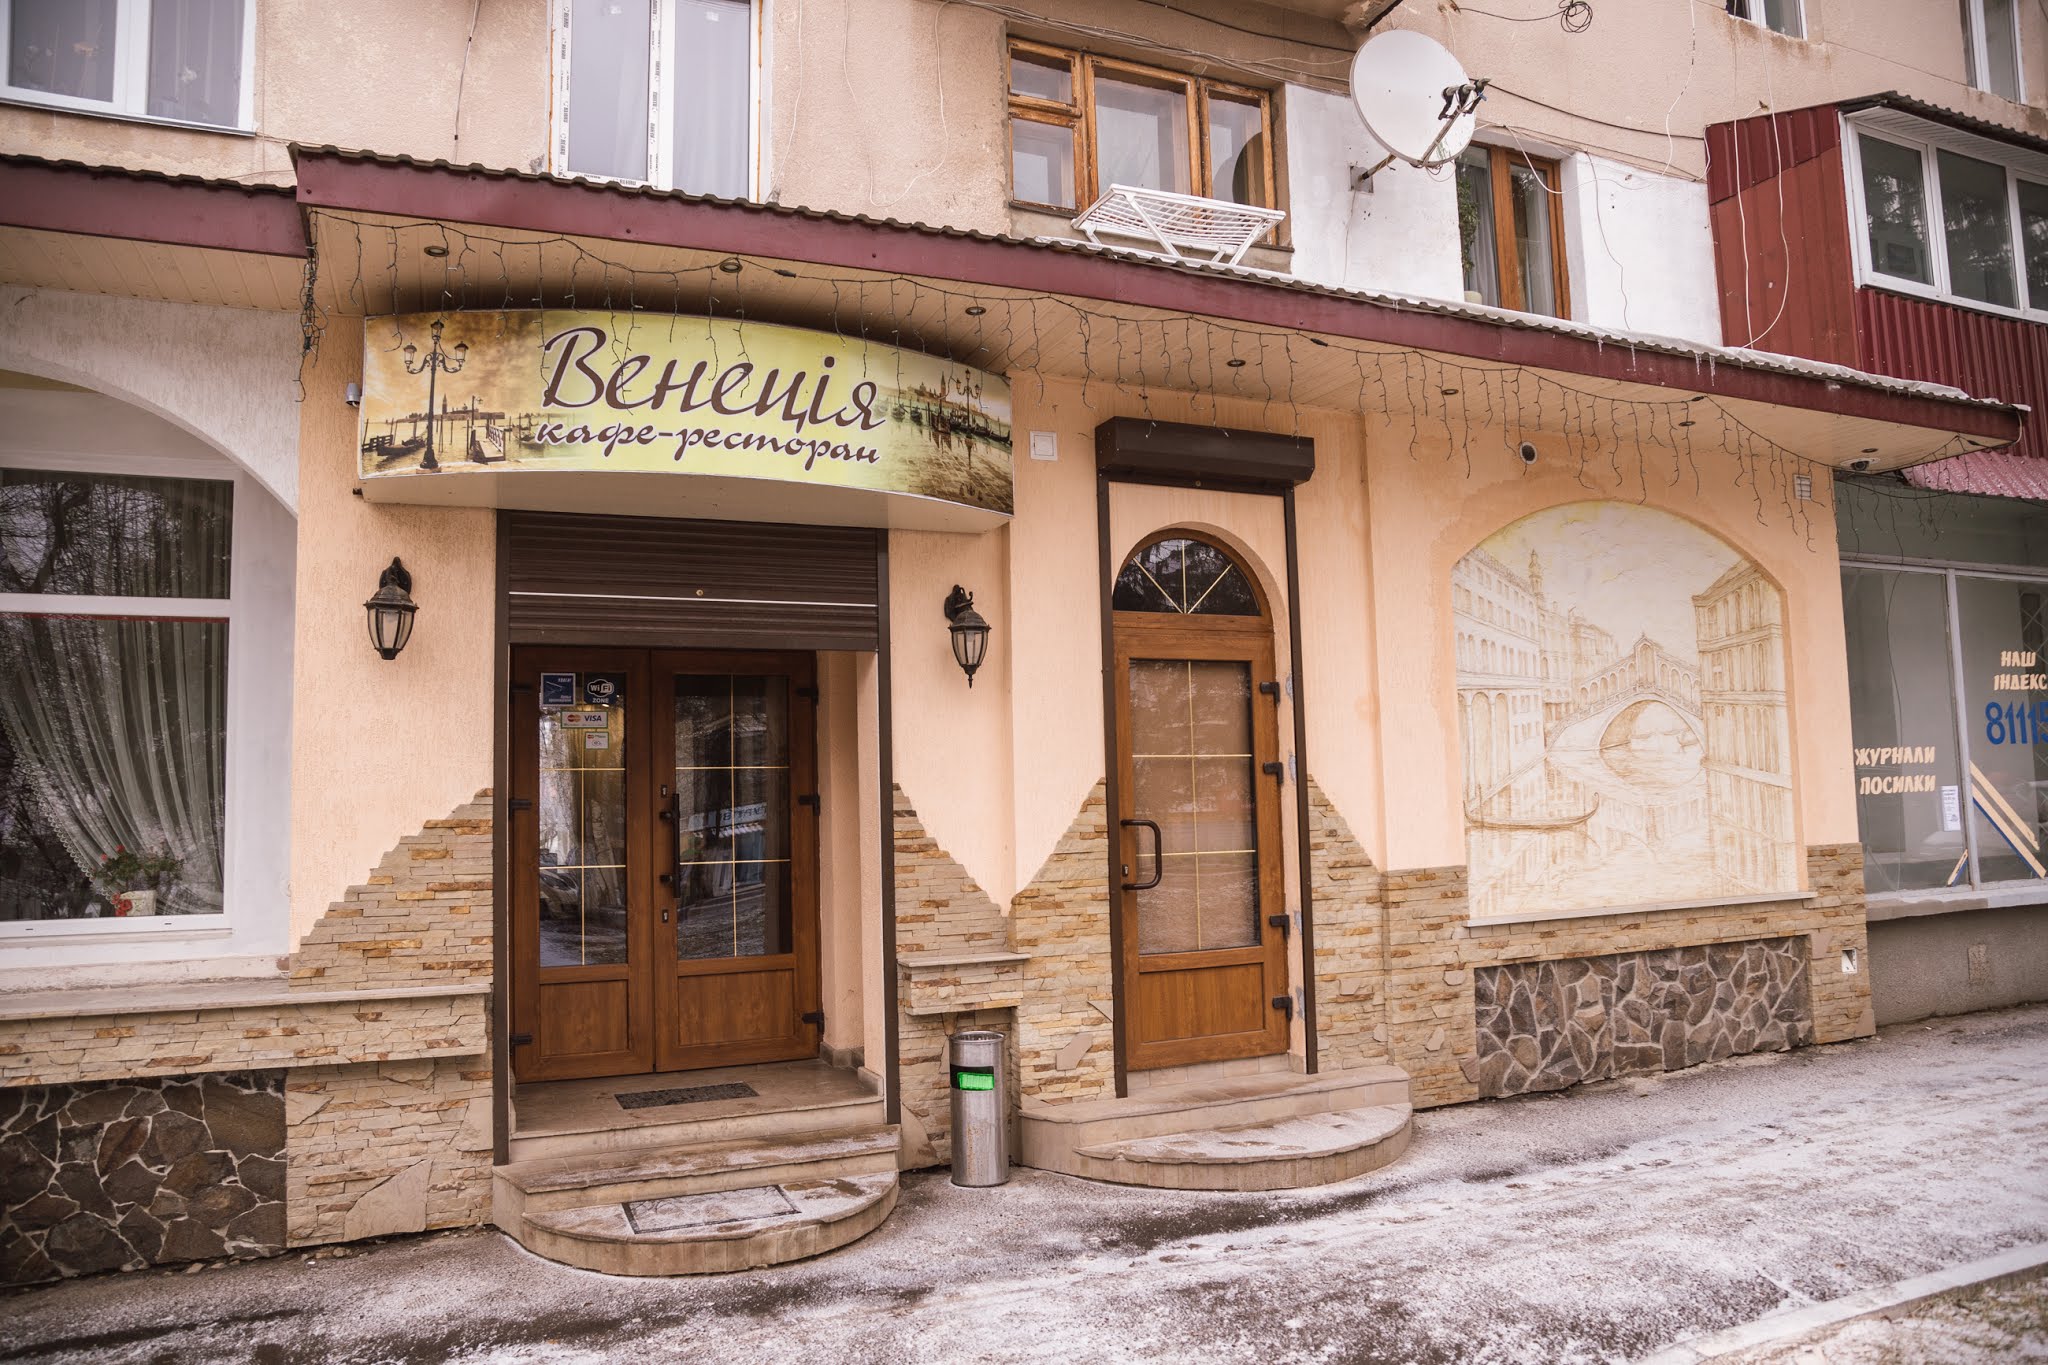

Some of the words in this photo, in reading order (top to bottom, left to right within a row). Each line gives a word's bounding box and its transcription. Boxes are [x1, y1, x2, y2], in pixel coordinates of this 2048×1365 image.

[542, 326, 886, 434] Венеція
[537, 422, 881, 471] кафе-ресторан
[2000, 650, 2037, 668] НАШ
[1993, 673, 2048, 691] ІНДЕКС
[1985, 701, 2048, 745] 81115
[1854, 746, 1936, 767] ЖУРНАЛИ
[1859, 775, 1936, 795] ПОСИЛКИ
